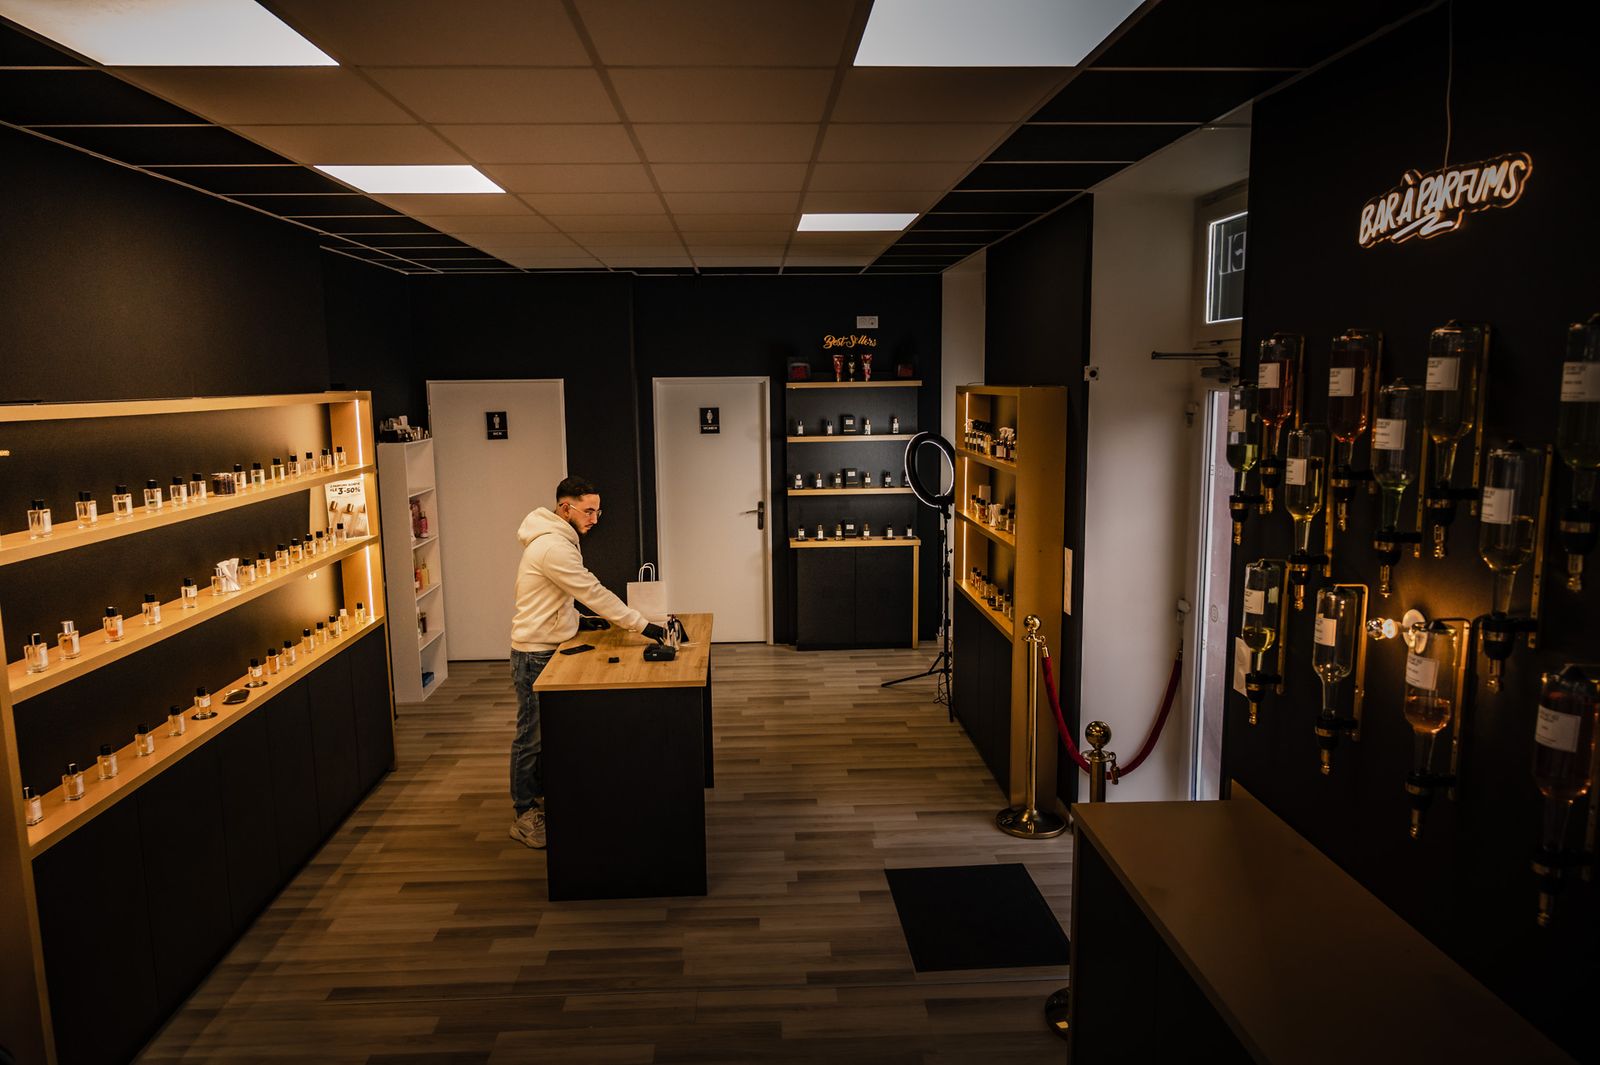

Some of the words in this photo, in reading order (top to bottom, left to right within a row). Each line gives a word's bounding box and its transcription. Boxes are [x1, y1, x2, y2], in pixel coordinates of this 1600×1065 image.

[1358, 192, 1401, 245] BAR
[1396, 173, 1414, 226] À
[1415, 159, 1527, 219] PARFUMS
[823, 334, 849, 349] Best
[846, 334, 877, 348] Sellers
